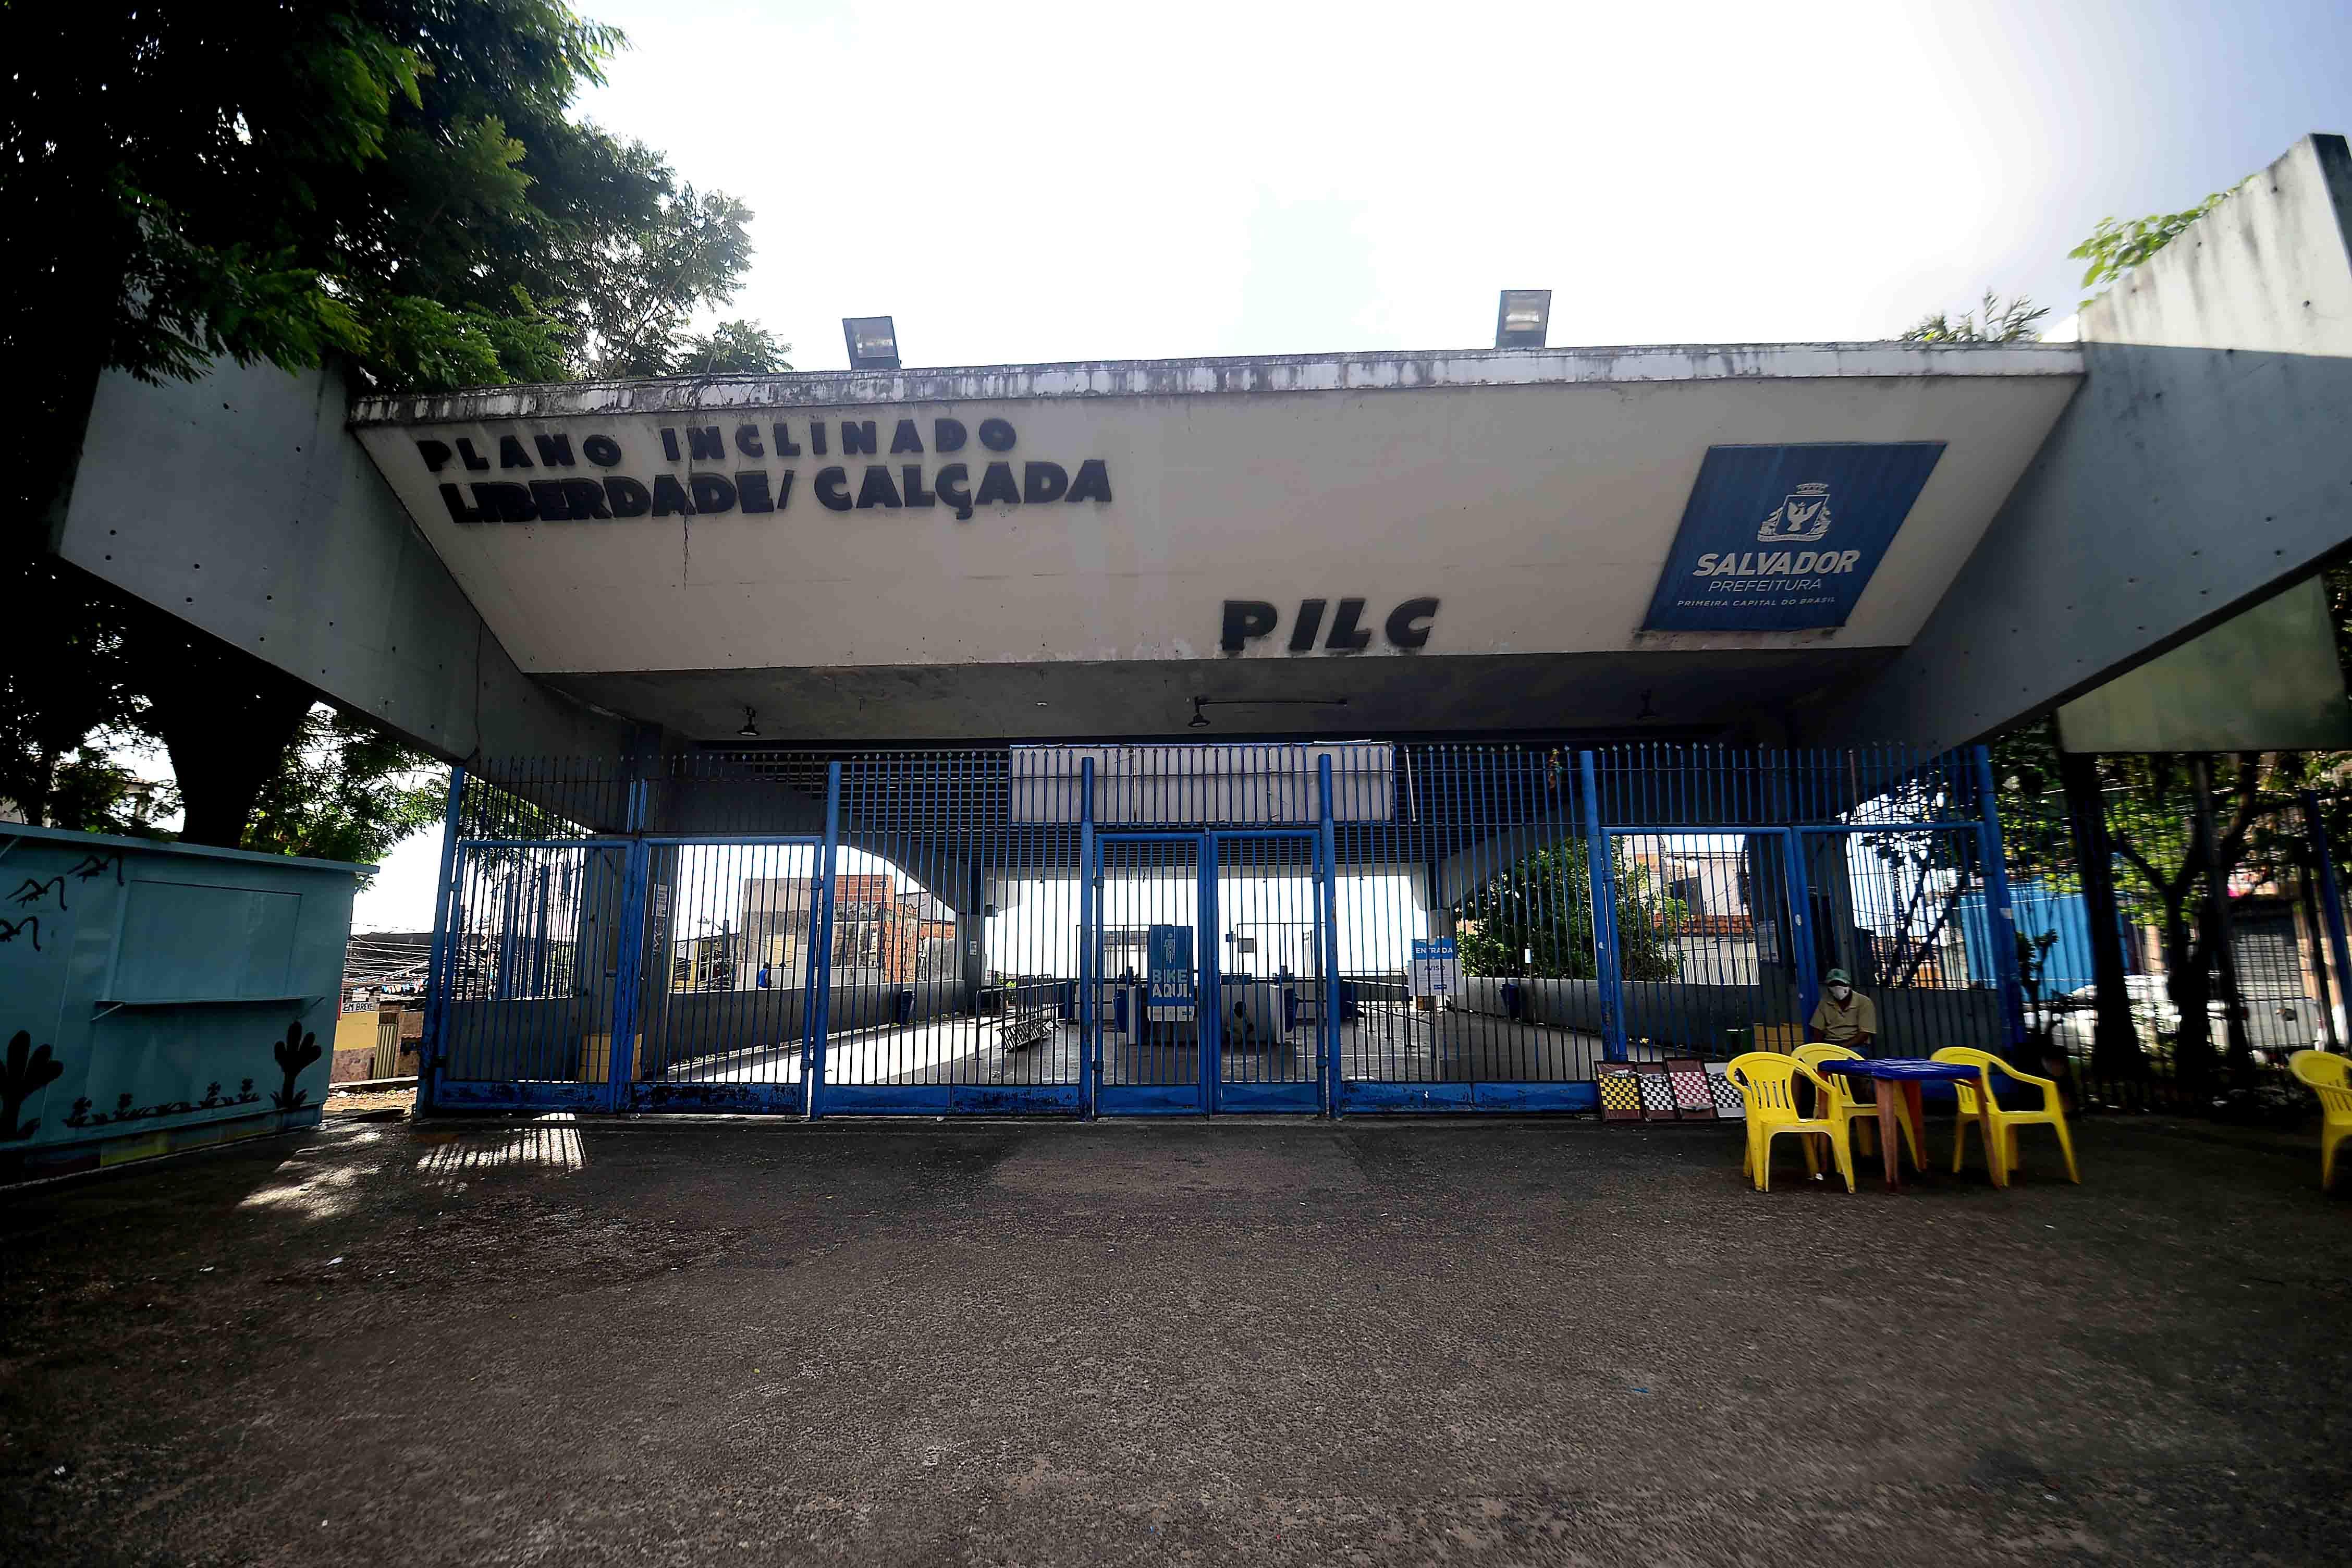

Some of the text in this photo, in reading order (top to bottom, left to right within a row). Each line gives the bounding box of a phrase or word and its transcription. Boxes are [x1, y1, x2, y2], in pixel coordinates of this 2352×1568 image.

[417, 418, 1017, 472] PLANO INCLINADO
[814, 459, 1112, 520] CALÇADA
[1693, 550, 1860, 577] SALVADOR
[1708, 579, 1822, 592] PREFEITURA
[1221, 597, 1439, 651] PILC
[1152, 969, 1188, 983] BIKE
[344, 1003, 354, 1011] EM
